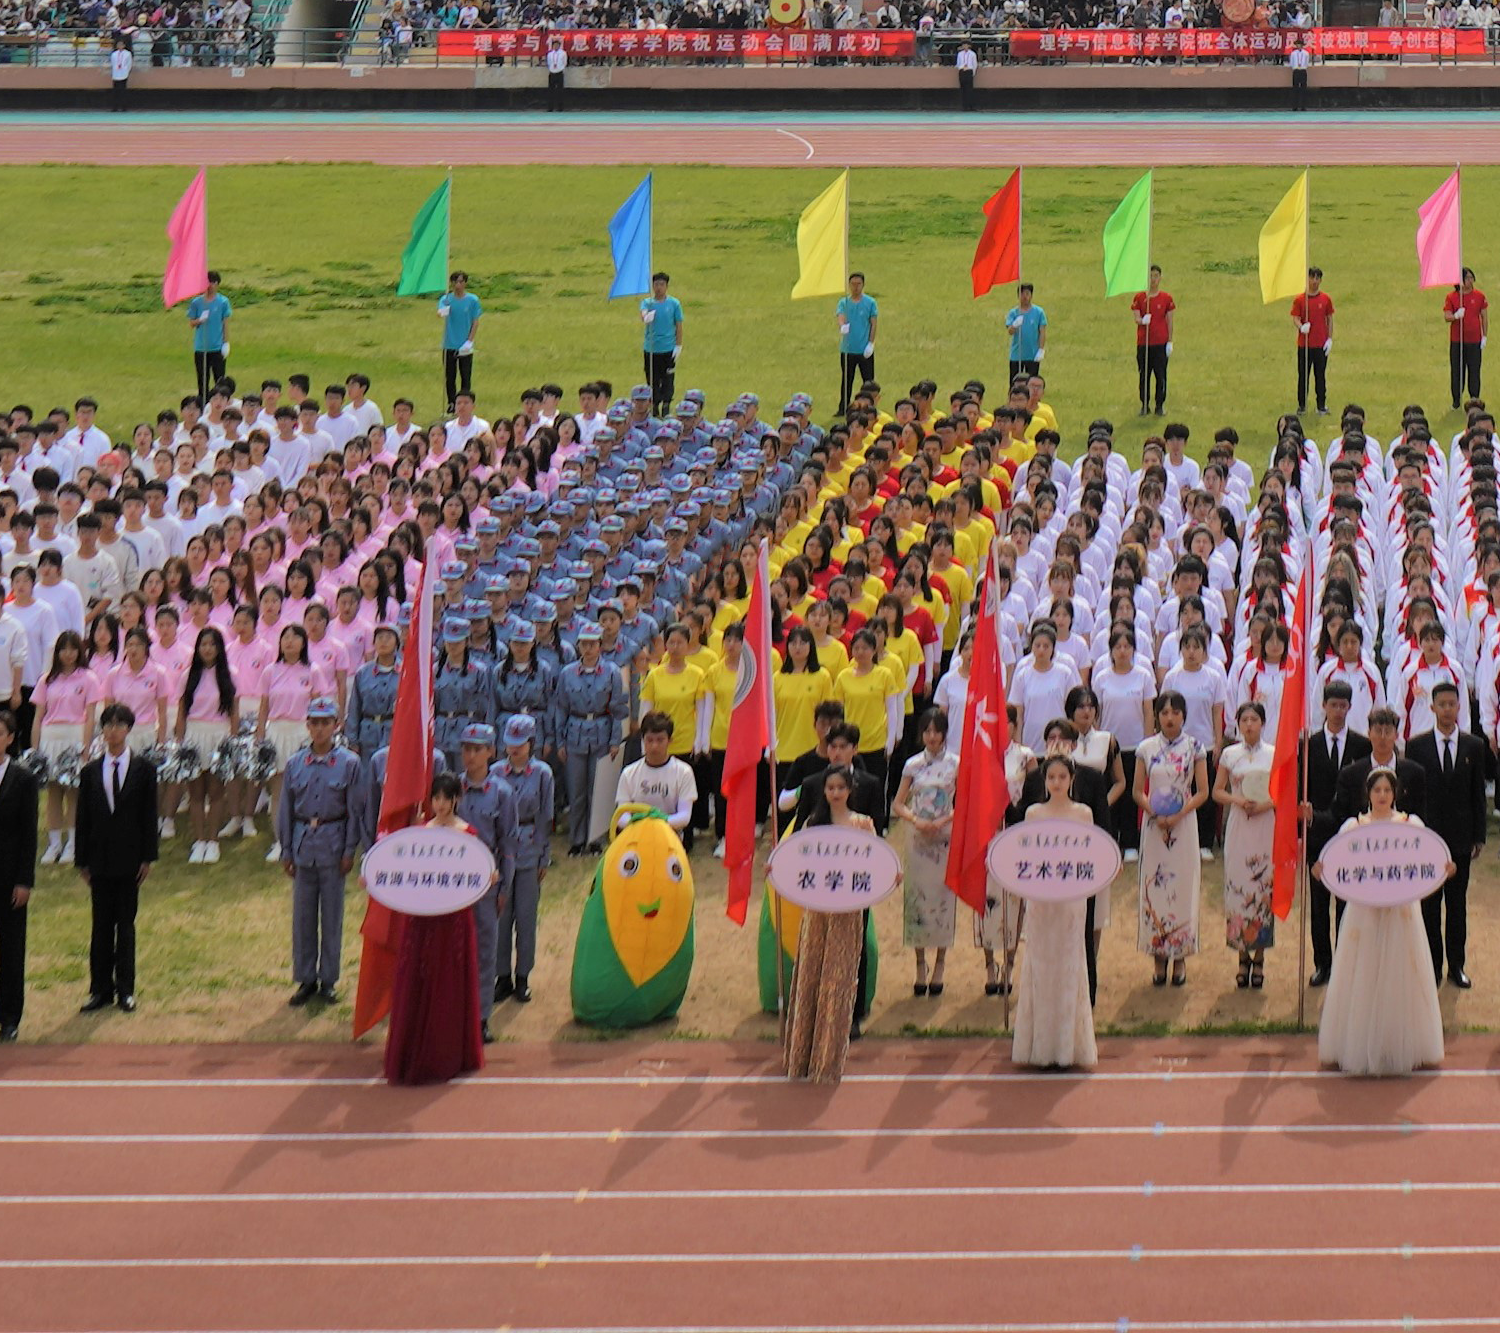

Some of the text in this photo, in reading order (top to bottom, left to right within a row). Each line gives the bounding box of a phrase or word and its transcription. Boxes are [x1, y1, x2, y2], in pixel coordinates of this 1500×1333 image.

[375, 871, 481, 889] 资源与环境学院
[797, 869, 872, 892] 农学院
[1015, 861, 1095, 881] 艺术学院
[1336, 863, 1437, 884] 化学与药学院
